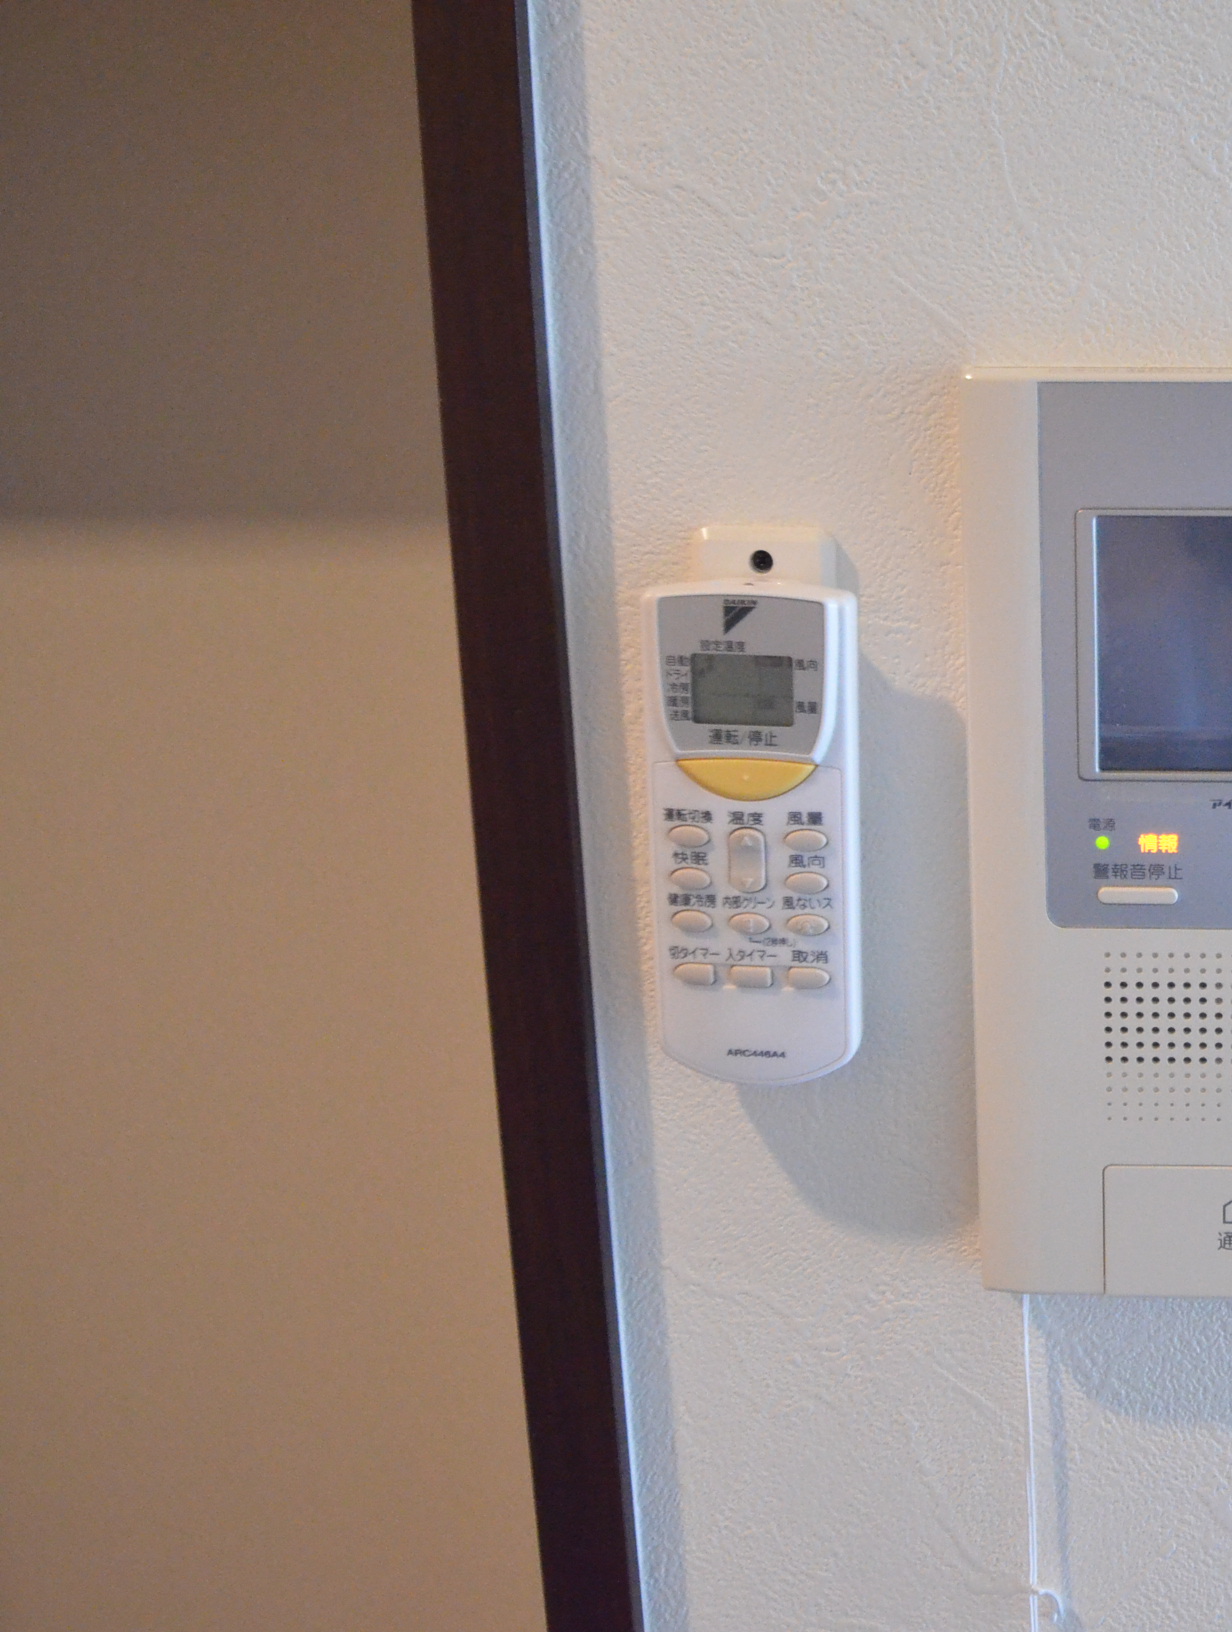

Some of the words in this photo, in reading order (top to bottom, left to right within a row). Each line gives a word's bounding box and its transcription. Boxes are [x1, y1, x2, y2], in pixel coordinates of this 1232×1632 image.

[795, 659, 818, 671] 風向
[795, 701, 818, 714] 風量
[709, 729, 778, 747] 運転/停止
[663, 808, 713, 823] 運転切換
[728, 811, 764, 826] 温度
[786, 812, 823, 826] 風量
[1088, 818, 1116, 831] 電源
[1138, 833, 1180, 854] 情報
[672, 852, 709, 866] 快眠
[787, 855, 825, 868] 風向
[1092, 863, 1183, 880] 警報音停止
[667, 893, 717, 908] 健康冷房
[669, 946, 721, 960] 切タイマー
[725, 948, 777, 962] 入タイマー
[791, 950, 829, 964] 取消
